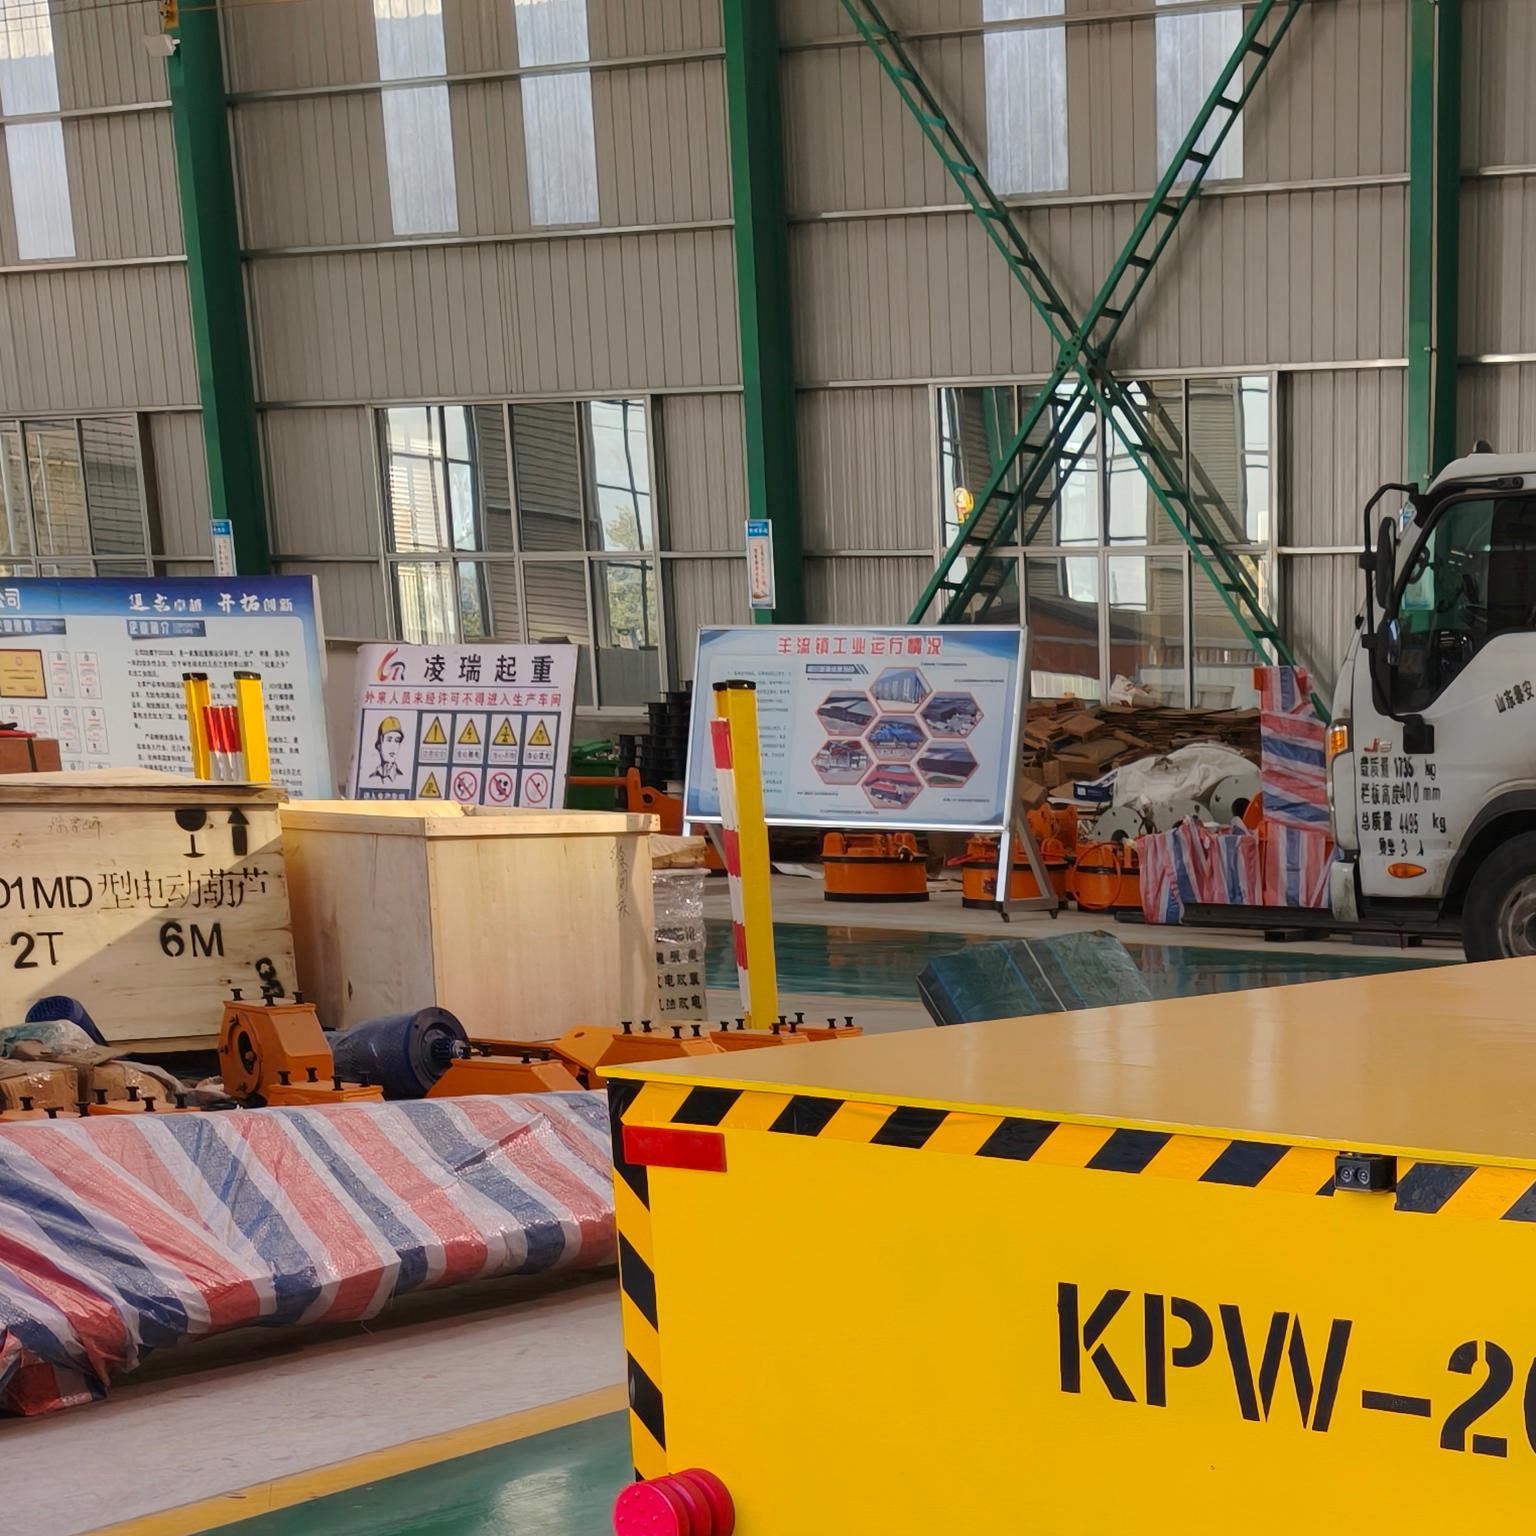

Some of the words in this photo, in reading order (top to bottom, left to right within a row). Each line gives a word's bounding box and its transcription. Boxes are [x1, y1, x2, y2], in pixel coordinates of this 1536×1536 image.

[424, 653, 554, 683] 凌瑞起重
[1423, 786, 1441, 801] mm
[1361, 811, 1392, 832] 总质量
[1432, 812, 1447, 834] kg
[10, 931, 64, 970] 2T
[159, 920, 225, 958] 6M
